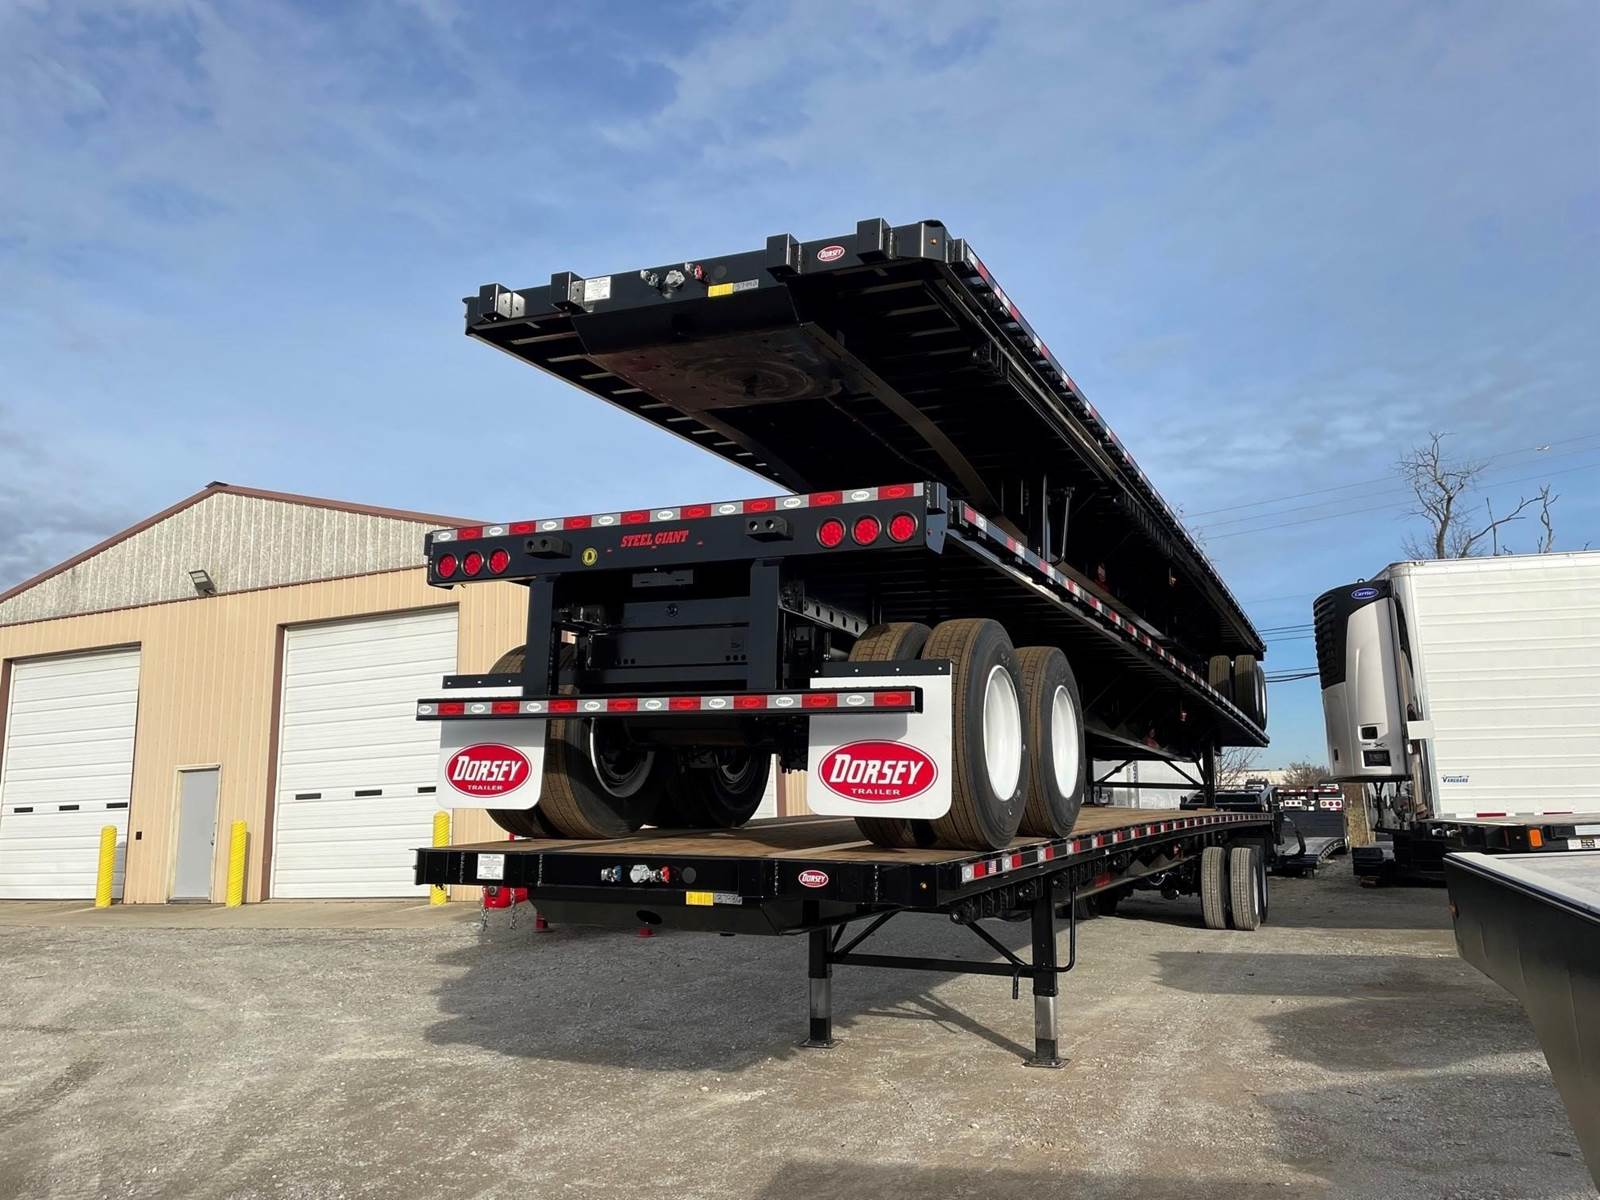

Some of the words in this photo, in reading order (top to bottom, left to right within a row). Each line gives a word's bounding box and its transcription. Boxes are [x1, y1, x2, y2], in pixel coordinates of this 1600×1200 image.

[621, 533, 653, 548] STEEL
[655, 530, 689, 545] GIANT
[452, 755, 522, 782] DORSEY
[829, 753, 924, 785] DORSEY
[850, 787, 901, 796] TRAILER
[801, 873, 826, 883] DORSEY
